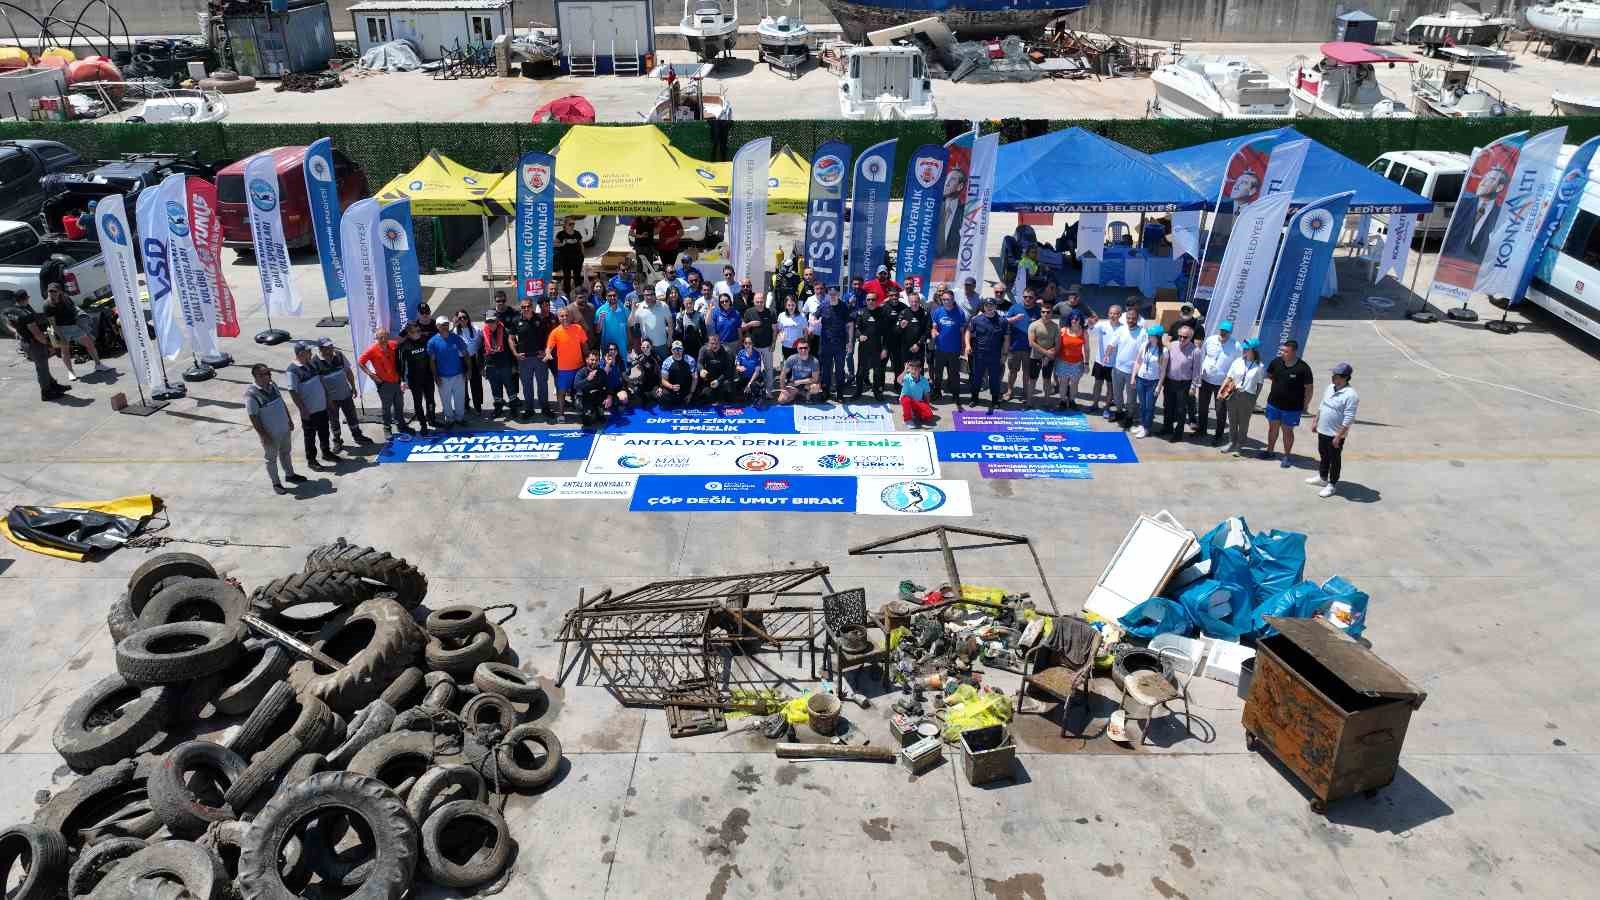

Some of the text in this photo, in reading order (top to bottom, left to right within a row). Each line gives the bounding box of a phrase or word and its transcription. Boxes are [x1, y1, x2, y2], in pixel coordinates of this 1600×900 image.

[1034, 204, 1102, 212] KONYAALTI
[1106, 203, 1177, 212] BELEDİYESİ
[1347, 205, 1401, 213] LEDİYESİ
[1494, 169, 1538, 269] KONYAALTI
[262, 221, 275, 263] SPORLARI
[522, 195, 534, 277] SAHİL GÜVENLİK
[536, 202, 548, 271] KOMUTANLIĞI
[808, 199, 838, 275] TSSF
[903, 189, 923, 273] SAHİL GÜVENLİK
[917, 197, 936, 269] KOMUTANLIĞI
[144, 237, 172, 302] VSD
[180, 247, 204, 323] SUALTI SPORLARI
[1226, 216, 1265, 324] ÜYÜKŞEHİR BELEDİYESİ
[1294, 247, 1313, 292] BELEDİYESİ
[443, 434, 539, 444] ANTALYA
[646, 416, 766, 424] DİPTEN ZİRVEYE
[671, 424, 739, 432] TEMİZLİK
[742, 438, 798, 446] DENİZ
[844, 438, 903, 447] TEMİZ
[950, 452, 983, 460] KIYI
[985, 451, 1065, 460] TEMİZLİĞİ
[981, 443, 1029, 451] DENİZ
[1032, 443, 1058, 451] DİP
[648, 495, 683, 506] ÇÖP
[686, 495, 736, 504] DEĞİL
